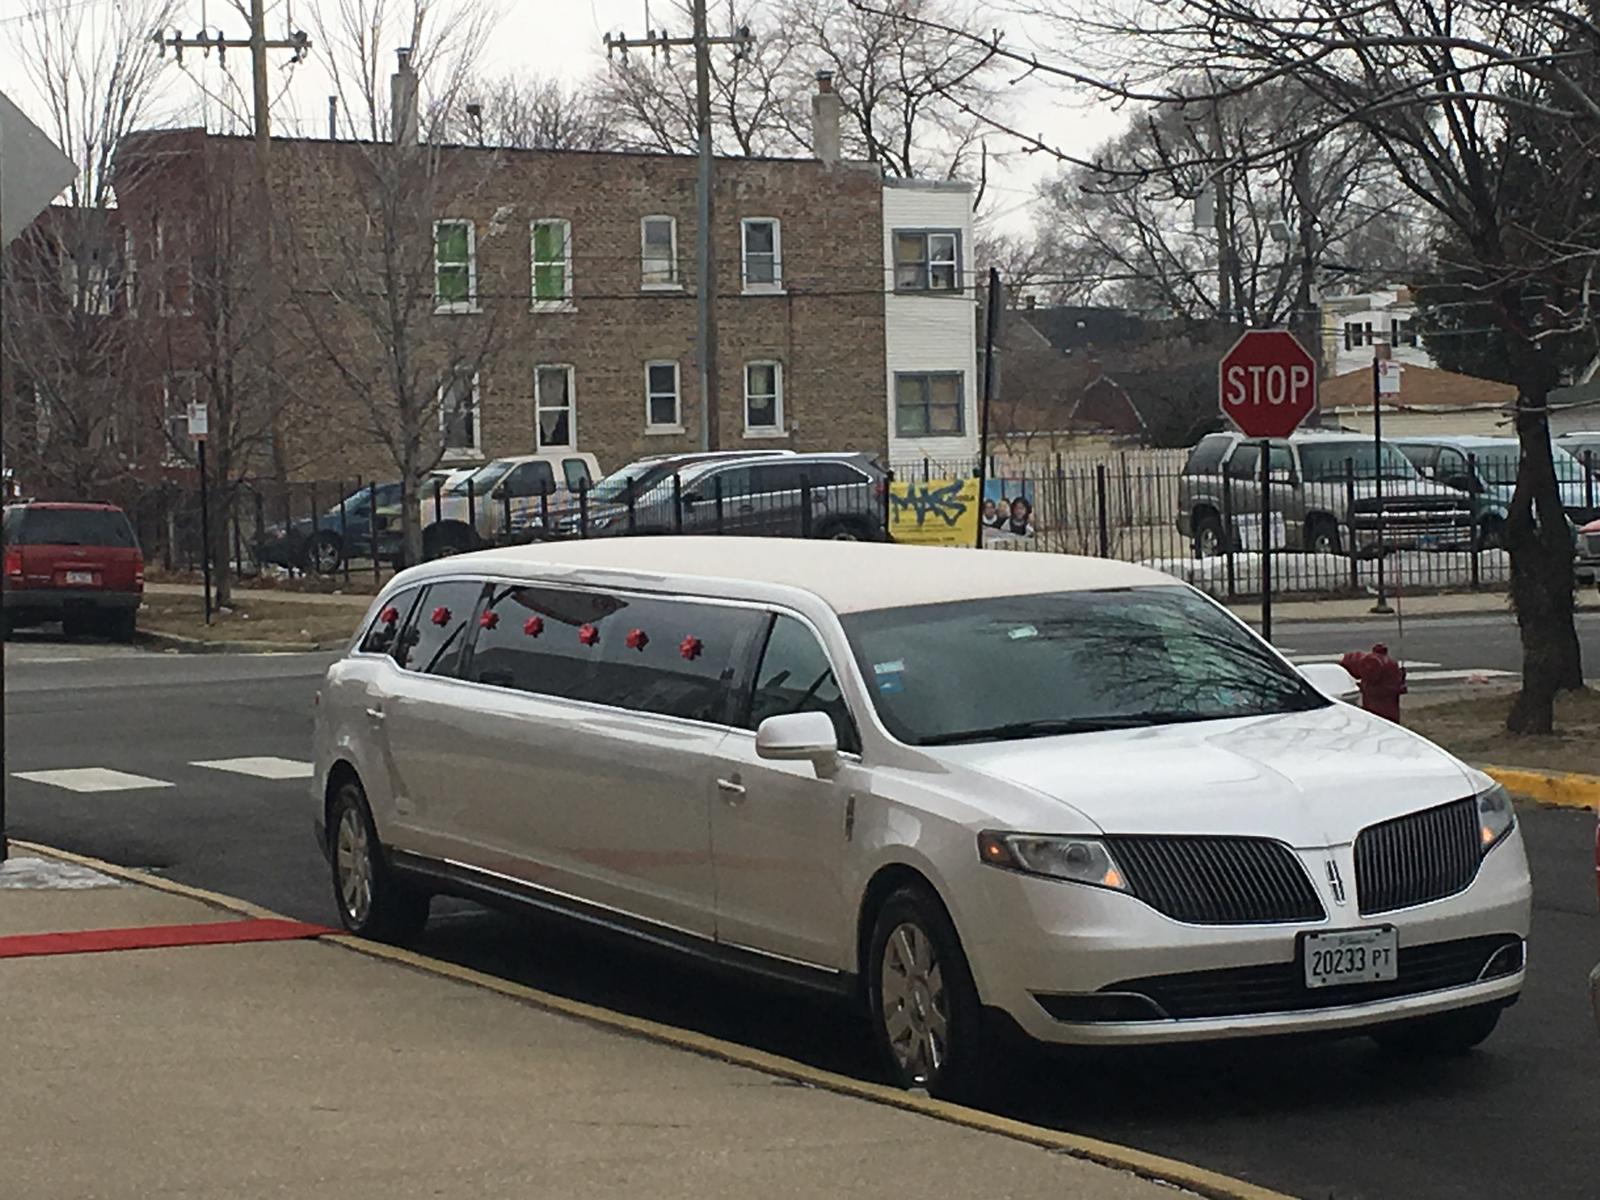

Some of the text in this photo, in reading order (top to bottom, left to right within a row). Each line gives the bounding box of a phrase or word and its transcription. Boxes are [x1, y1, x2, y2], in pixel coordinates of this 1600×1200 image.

[1226, 365, 1310, 405] STOP
[1312, 947, 1391, 976] 20233 PT
